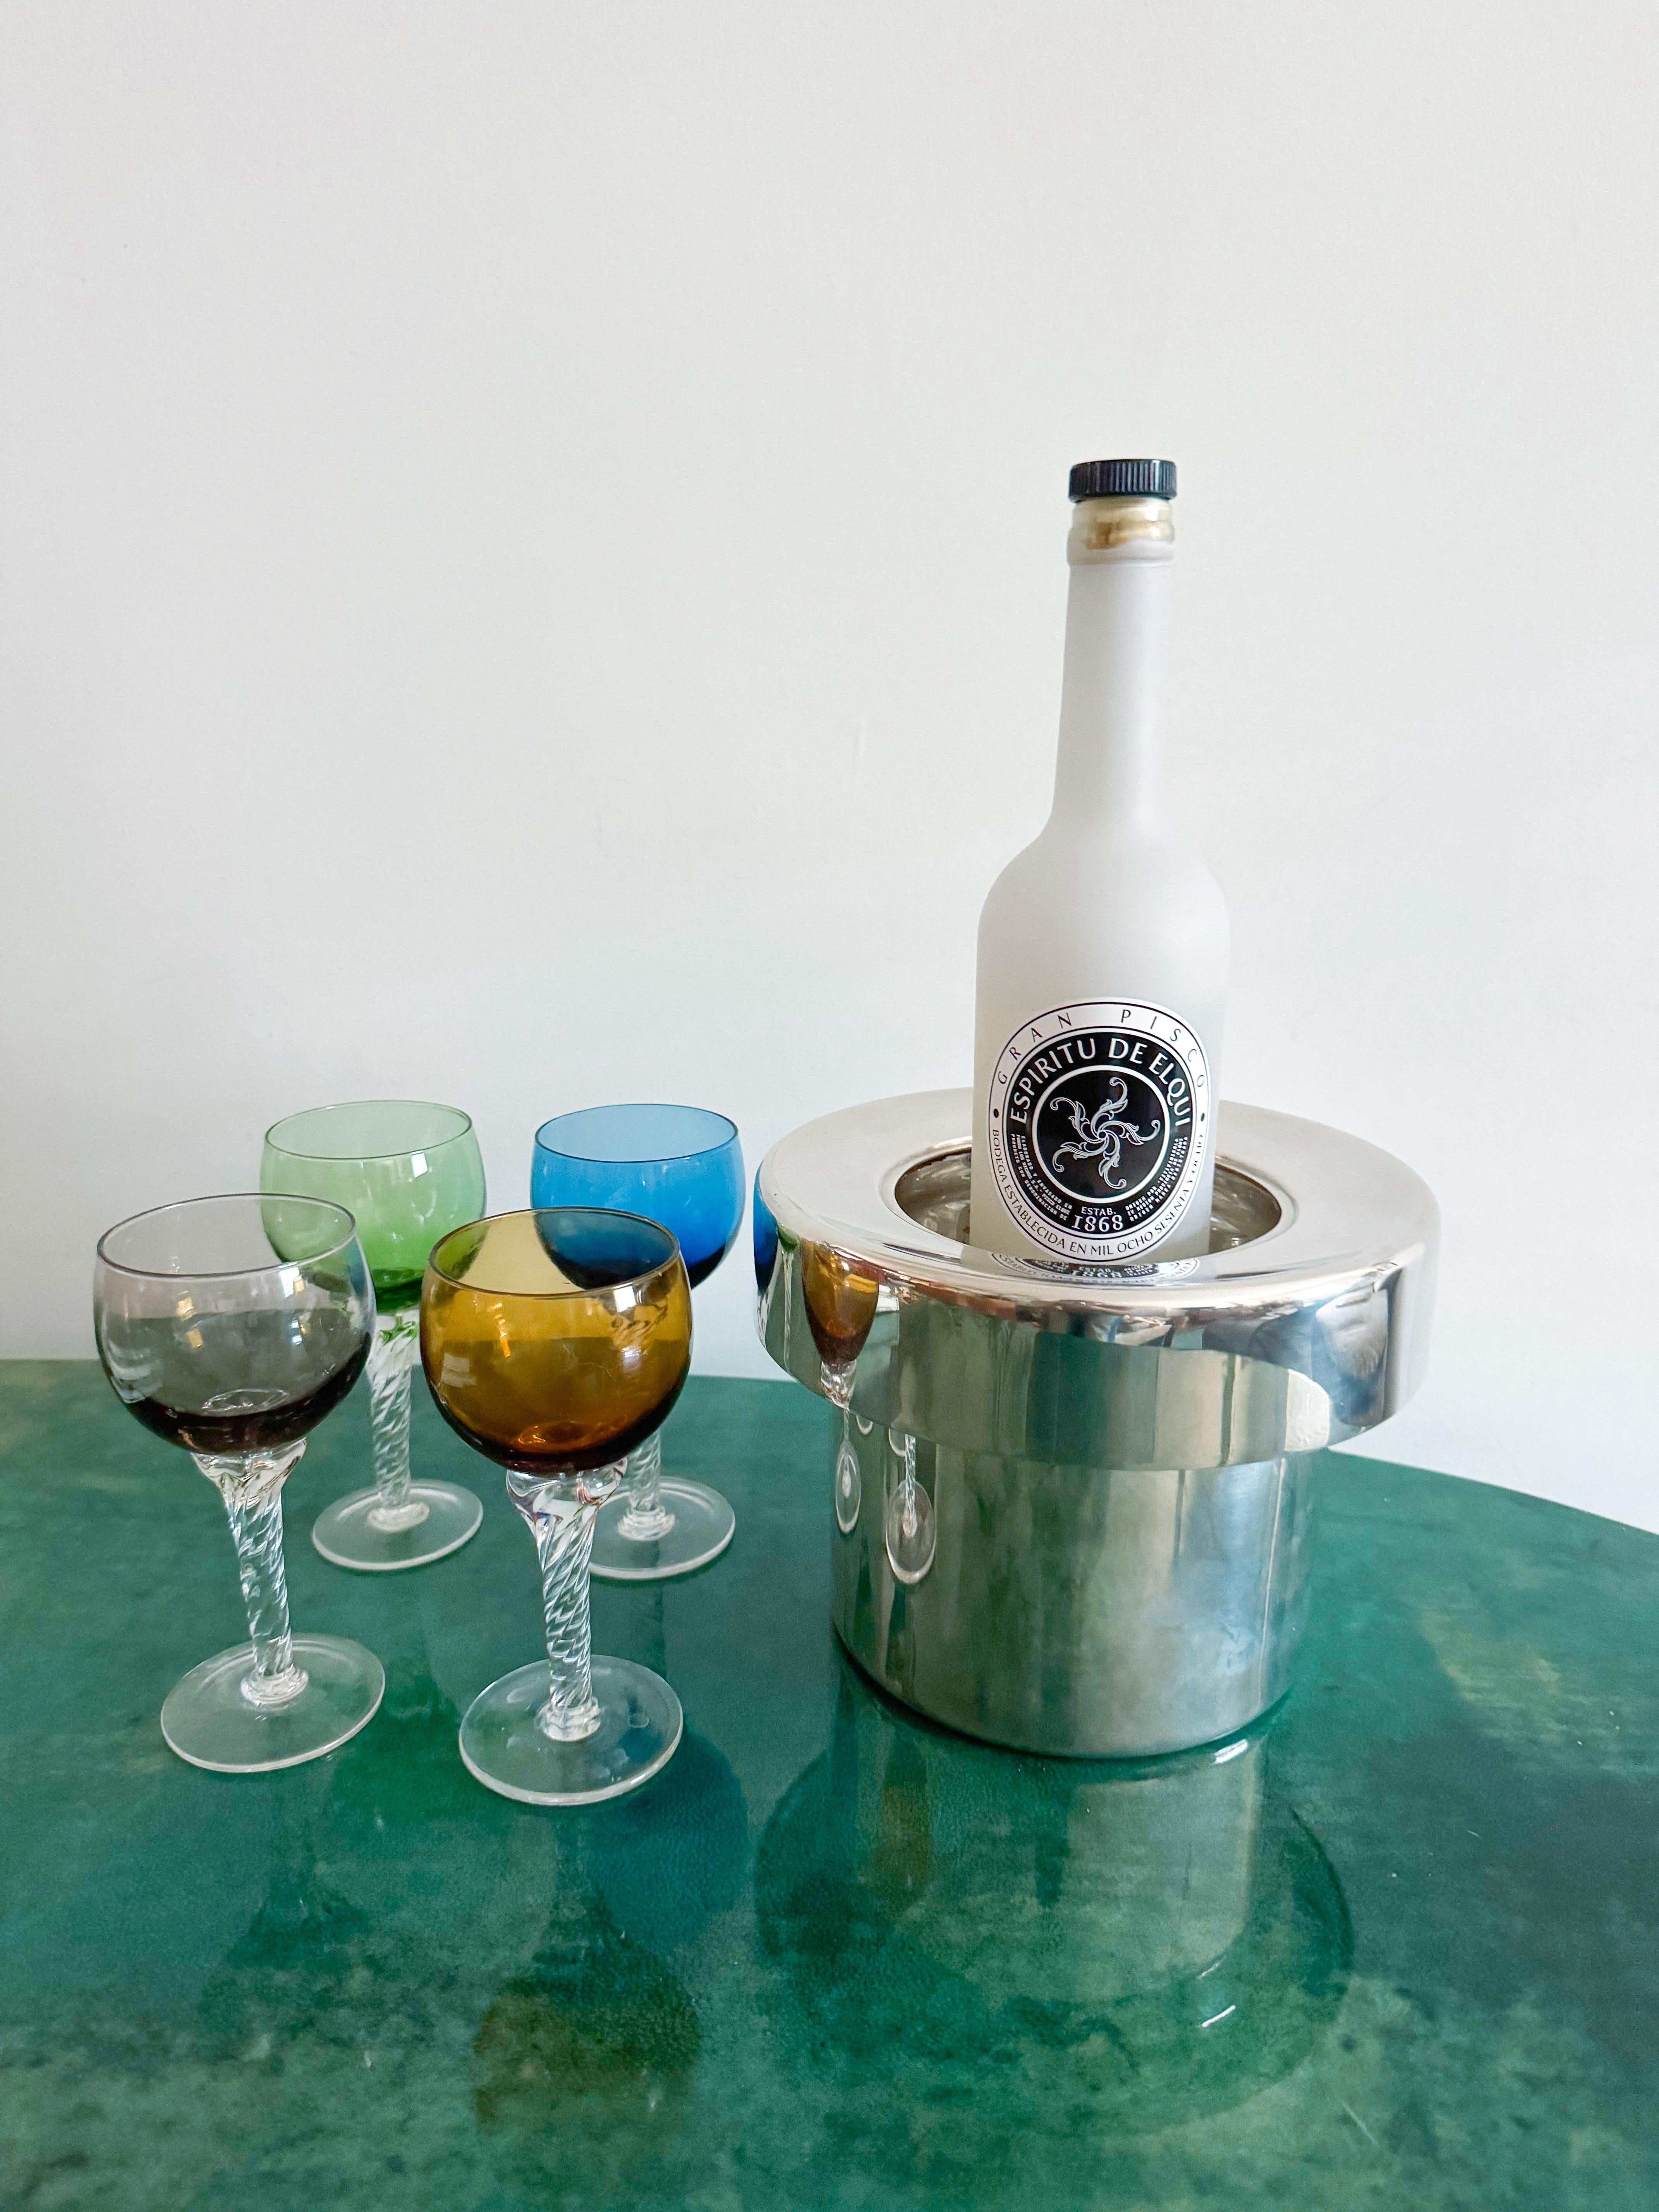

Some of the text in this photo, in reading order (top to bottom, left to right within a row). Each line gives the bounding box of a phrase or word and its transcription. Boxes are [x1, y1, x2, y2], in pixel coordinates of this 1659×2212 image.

[998, 1009, 1205, 1087] GRAN PISCO
[1010, 1038, 1190, 1126] ESPIRITU DE ELQUI
[993, 1129, 1007, 1182] BODEGA
[1004, 1185, 1065, 1249] ESTABLECIDA
[1070, 1242, 1087, 1255] EN
[1091, 1245, 1113, 1256] MIL
[1117, 1231, 1153, 1252] OCHO
[1154, 1190, 1189, 1234] SESENTA
[1071, 1215, 1123, 1233] 1868
[1081, 1206, 1116, 1216] ESTAB.
